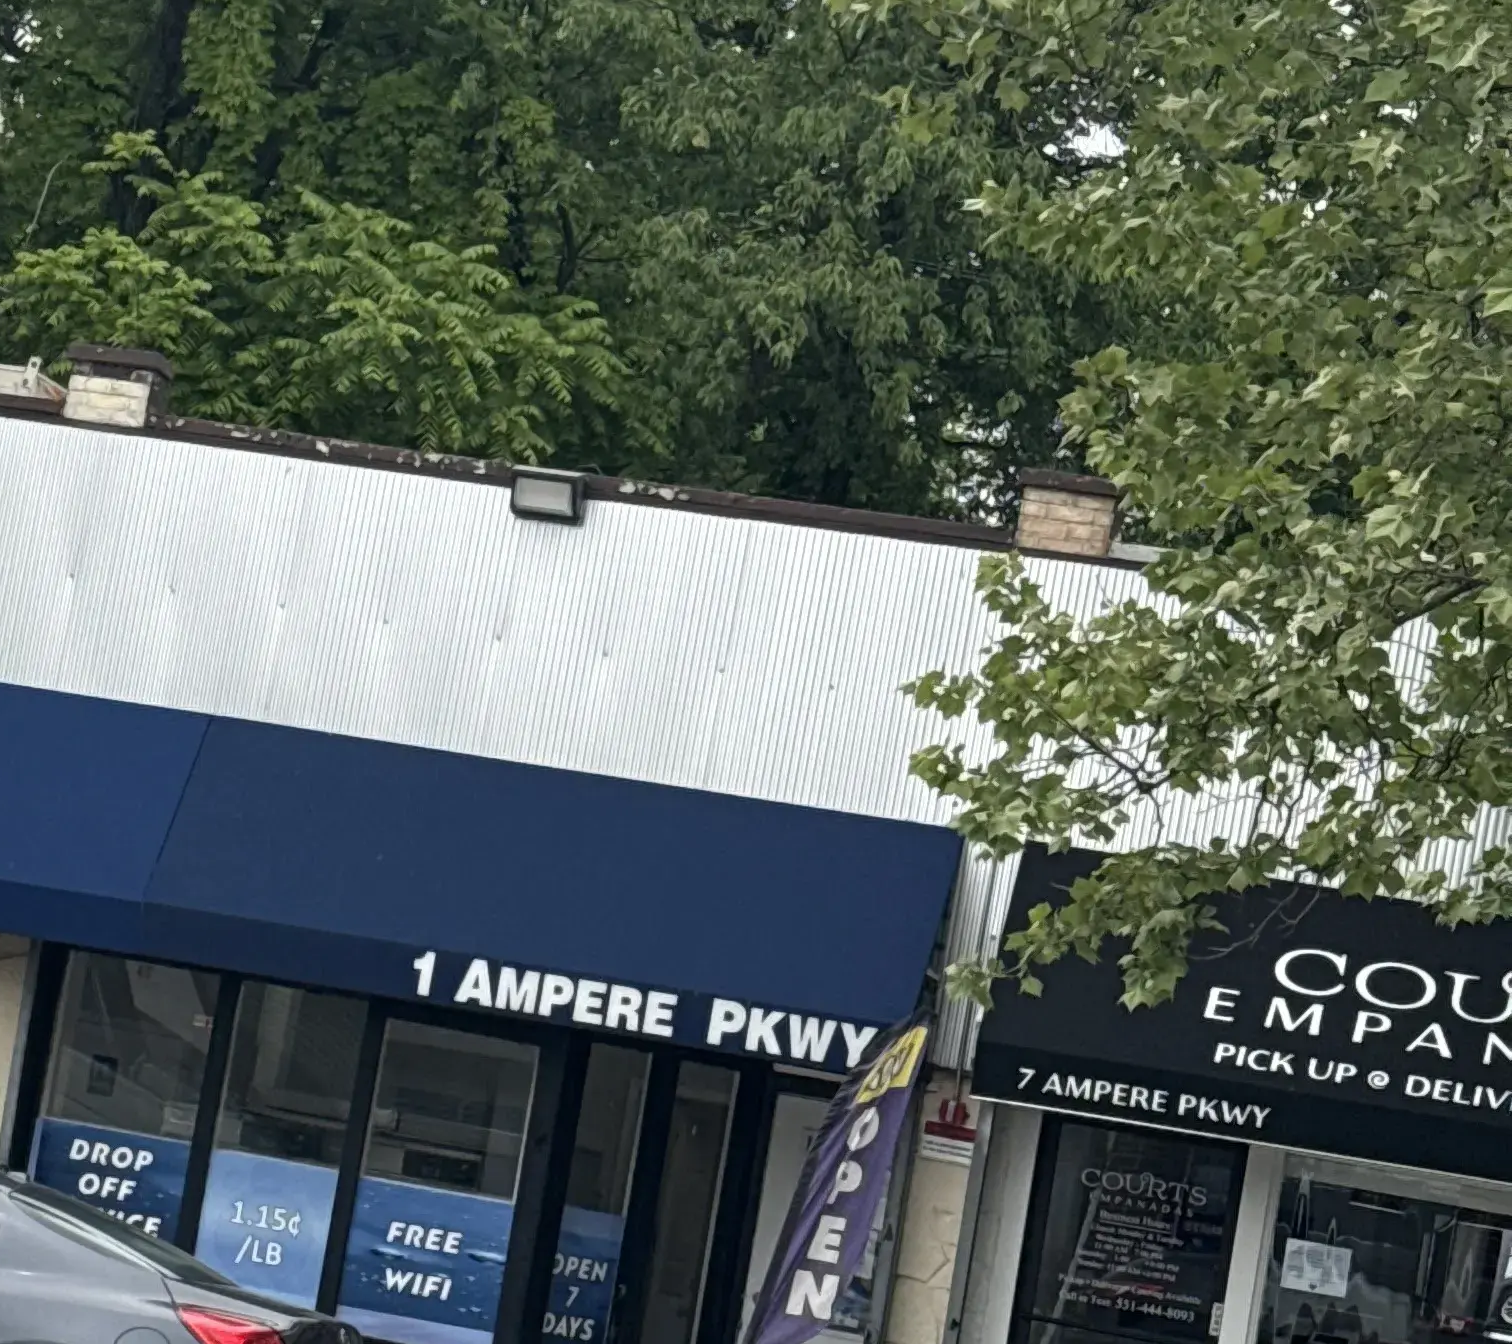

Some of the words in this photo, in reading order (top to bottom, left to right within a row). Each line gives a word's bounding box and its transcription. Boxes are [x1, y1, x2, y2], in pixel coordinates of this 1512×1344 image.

[413, 951, 437, 997] 1
[454, 958, 678, 1038] AMPERE
[706, 997, 880, 1068] PKWY
[1213, 1043, 1295, 1075] PICK
[1307, 1058, 1358, 1084] UP
[1404, 1074, 1512, 1110] DELIV
[1017, 1067, 1036, 1089] 7
[1041, 1072, 1169, 1113] AMPERE
[1177, 1093, 1272, 1128] PKWY
[69, 1139, 154, 1172] DROP
[78, 1173, 137, 1202] OFF
[1081, 1168, 1207, 1206] COURTS
[785, 1106, 879, 1321] OPEN
[234, 1235, 282, 1266] /LB
[386, 1221, 464, 1255] FREE
[385, 1267, 452, 1301] WIFI
[565, 1286, 580, 1308] 7
[541, 1312, 595, 1341] DAYS
